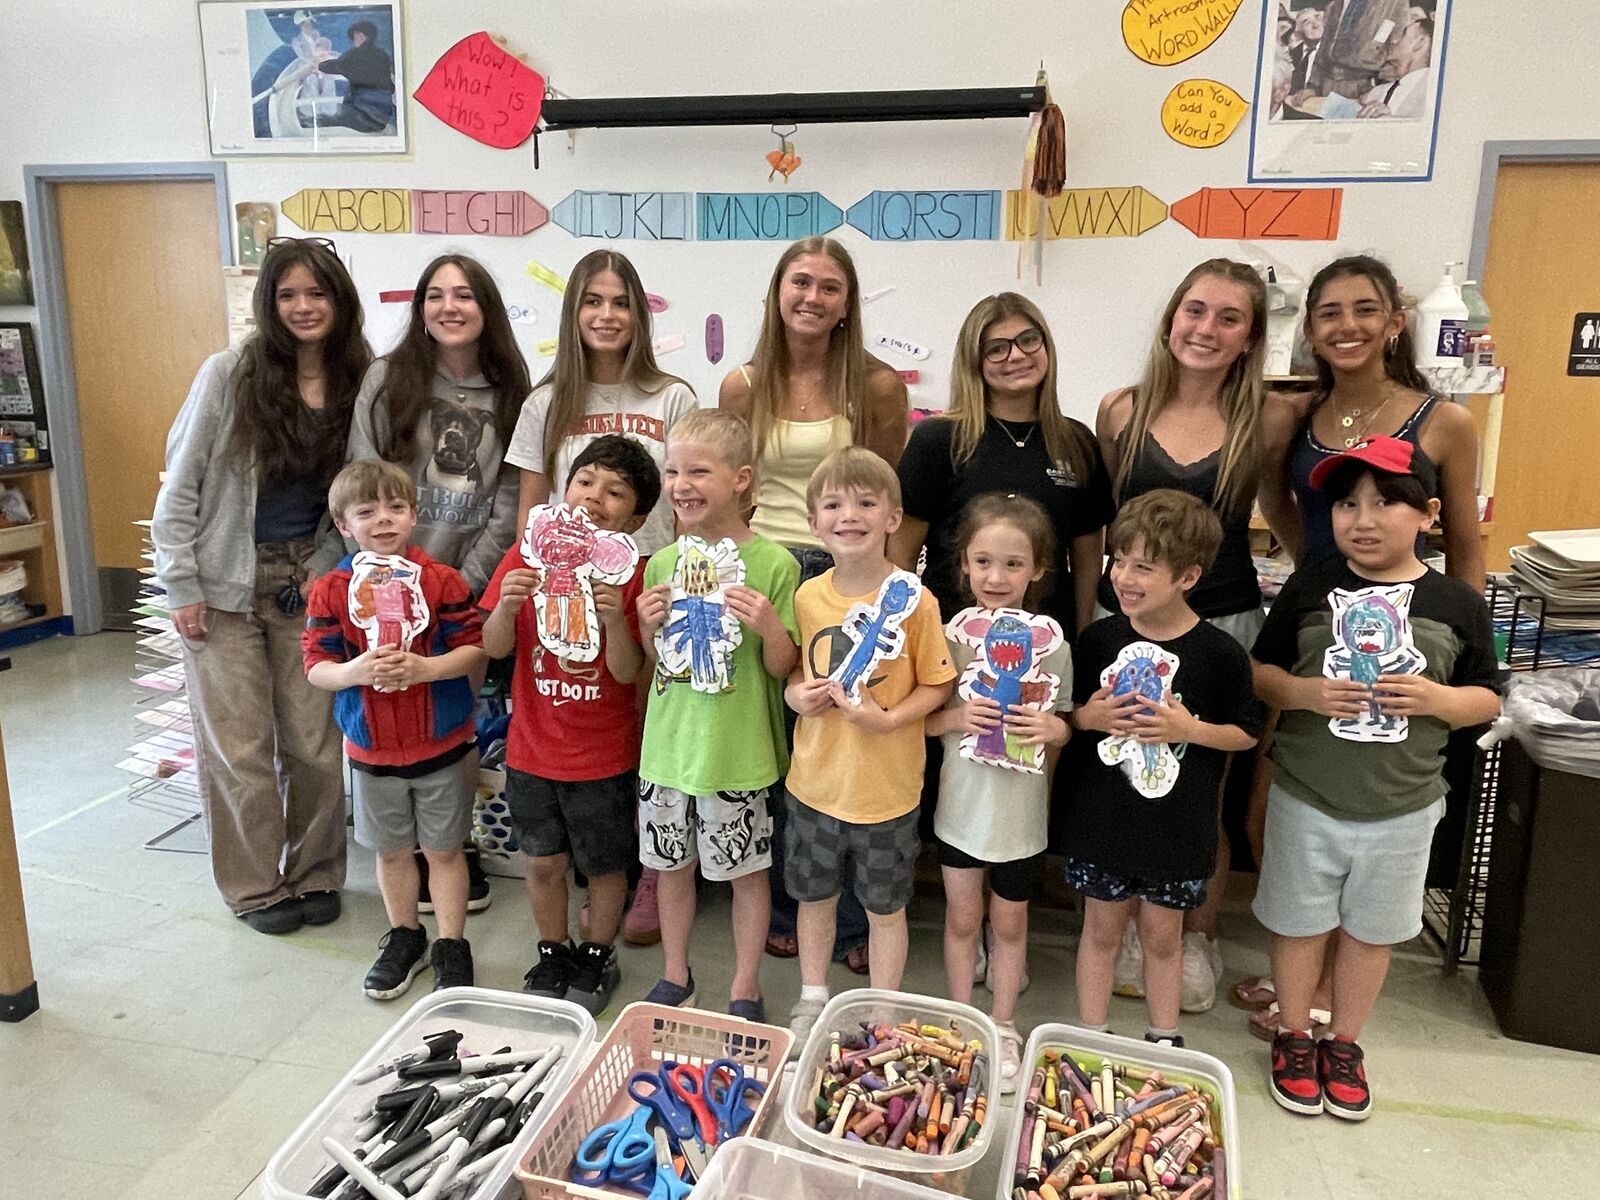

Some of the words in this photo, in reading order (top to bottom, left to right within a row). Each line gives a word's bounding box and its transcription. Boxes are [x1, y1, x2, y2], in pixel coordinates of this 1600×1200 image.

[1140, 30, 1199, 60] WORD
[444, 63, 493, 97] What
[508, 86, 525, 112] is
[1177, 84, 1204, 99] Can
[1209, 86, 1233, 107] You
[1180, 102, 1202, 114] add
[1209, 110, 1217, 119] a
[311, 190, 405, 233] ABCD
[421, 190, 515, 235] EFGH
[581, 193, 684, 240] IJKL
[706, 194, 809, 239] MNOP
[881, 192, 989, 240] QRST
[1229, 190, 1302, 237] YZ
[432, 487, 494, 509] BUL
[535, 678, 560, 696] UST
[561, 682, 583, 700] DO
